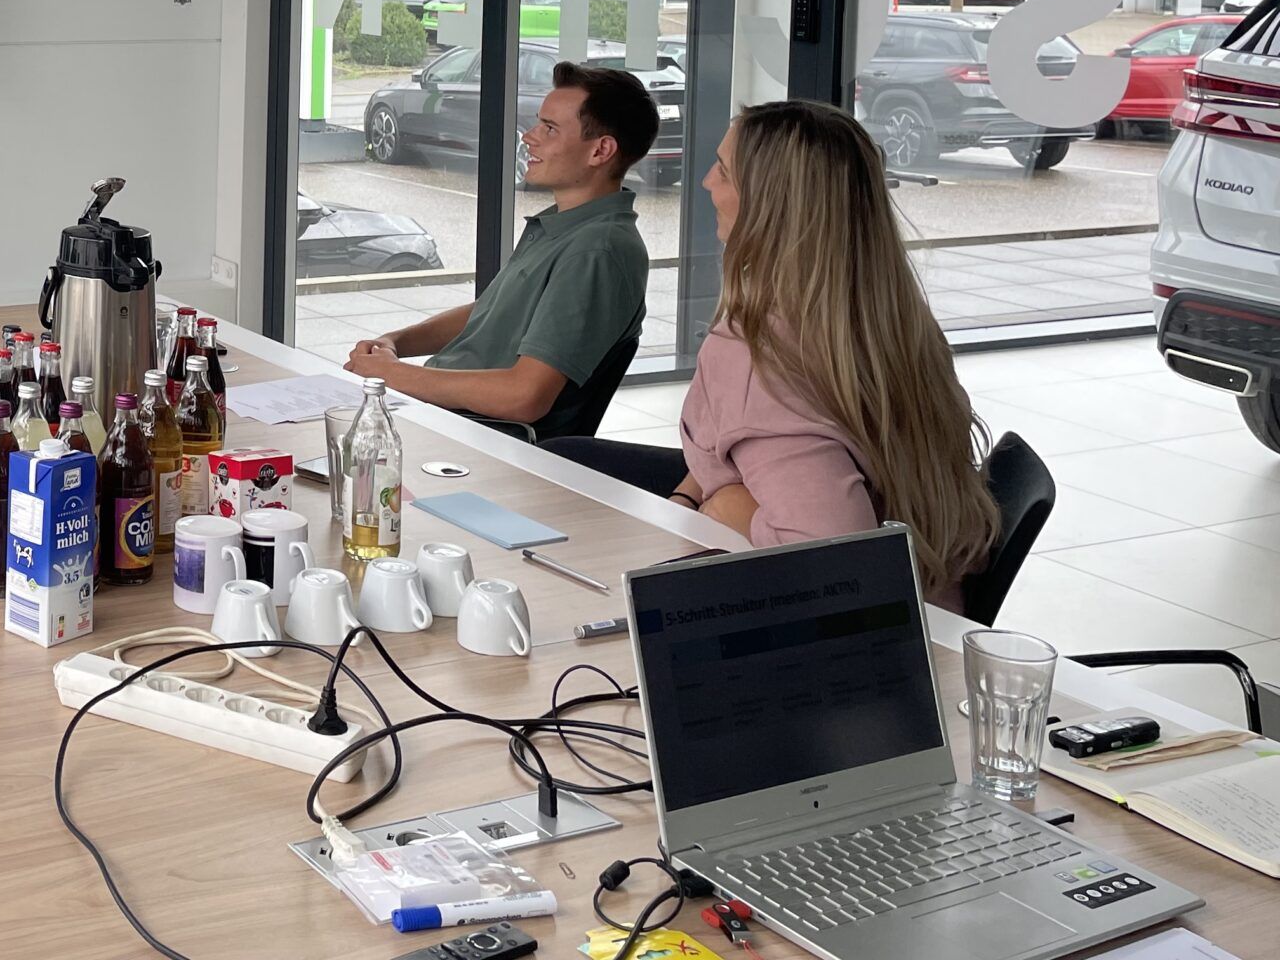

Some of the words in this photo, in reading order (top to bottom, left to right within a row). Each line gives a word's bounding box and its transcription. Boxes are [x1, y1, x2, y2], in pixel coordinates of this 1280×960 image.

[1204, 177, 1255, 196] KODIAQ
[127, 518, 154, 536] COL
[56, 529, 89, 550] milch
